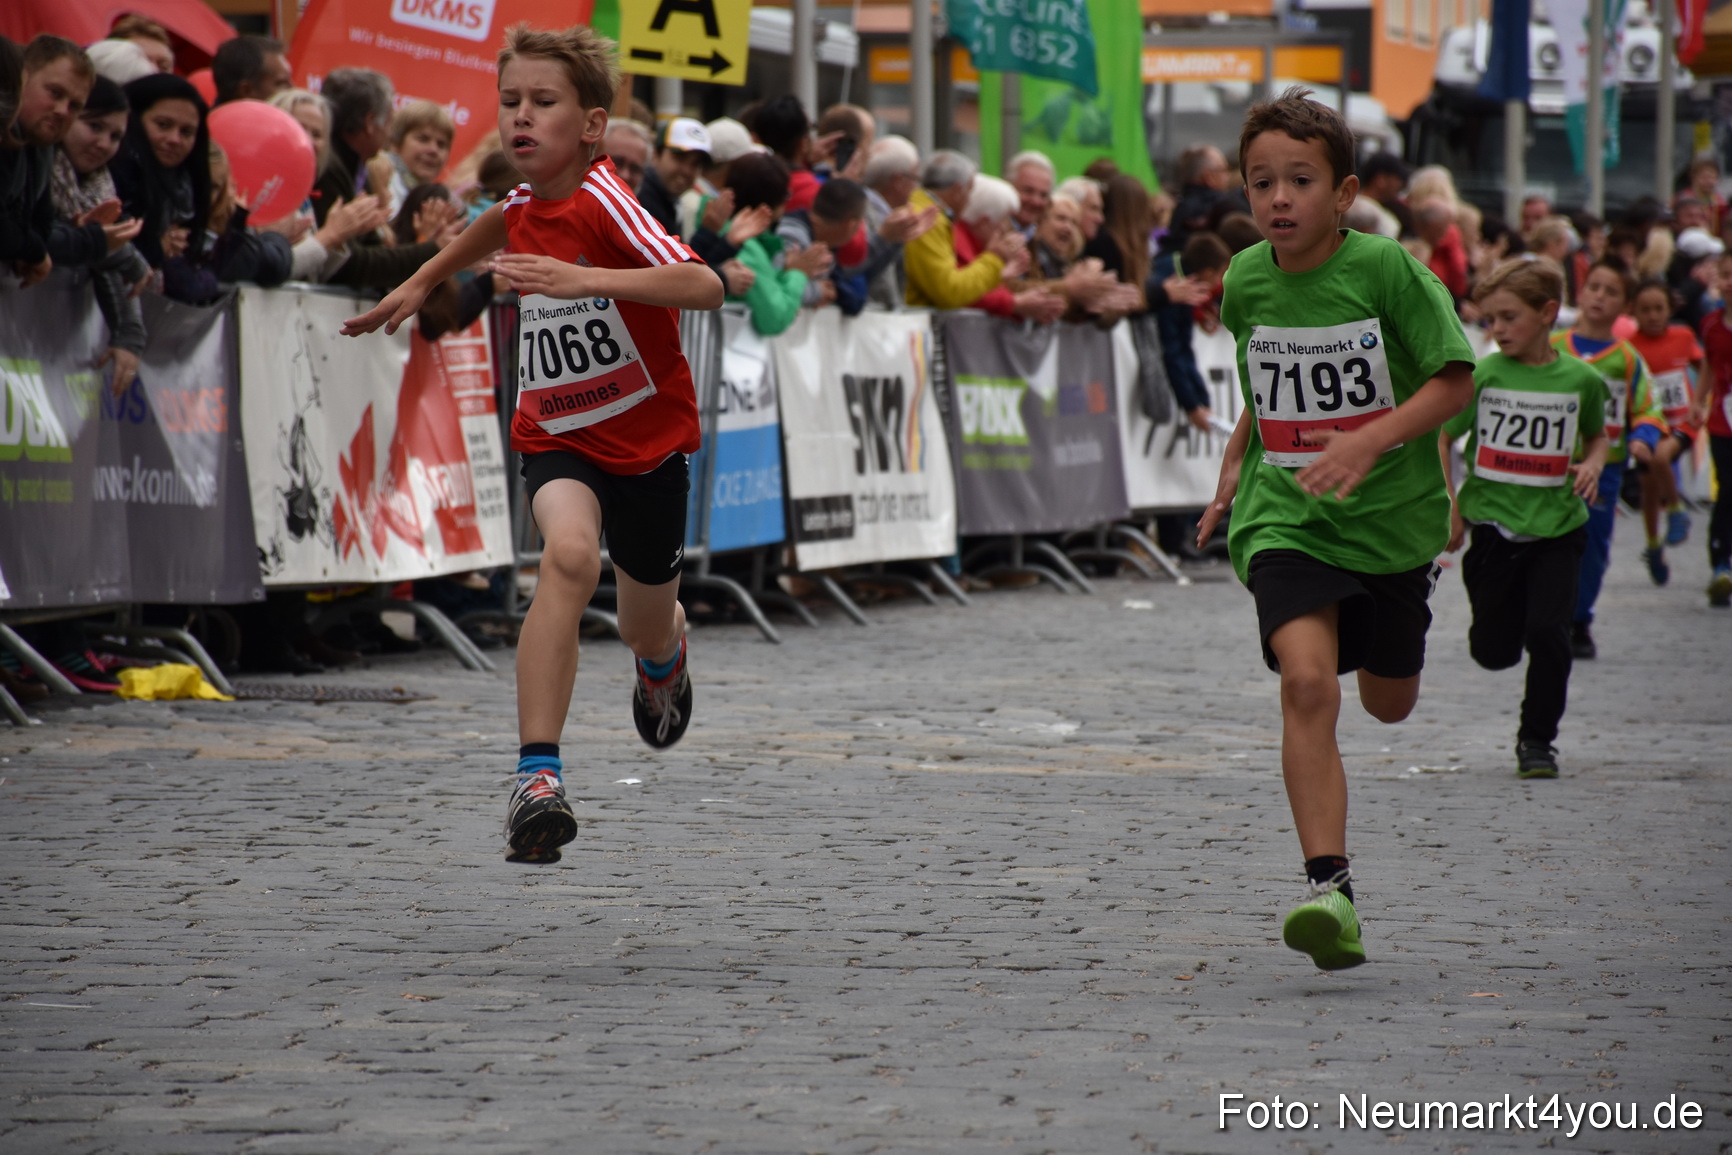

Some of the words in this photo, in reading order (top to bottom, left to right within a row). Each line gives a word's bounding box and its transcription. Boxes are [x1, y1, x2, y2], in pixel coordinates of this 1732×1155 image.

[401, 0, 484, 29] DKMS
[349, 27, 374, 43] Wir
[376, 34, 432, 60] besiegen
[443, 48, 498, 74] Blutkre
[538, 301, 590, 320] Neumarkt
[523, 318, 621, 381] 7068
[1250, 339, 1285, 354] PARTL
[1287, 340, 1354, 354] Neumarkt
[539, 382, 620, 416] Johannes
[1260, 357, 1376, 412] 7193
[1481, 396, 1513, 409] PARTL
[1516, 401, 1563, 412] Neumarkt
[1490, 410, 1566, 450] 7201
[1494, 454, 1551, 473] Matthias
